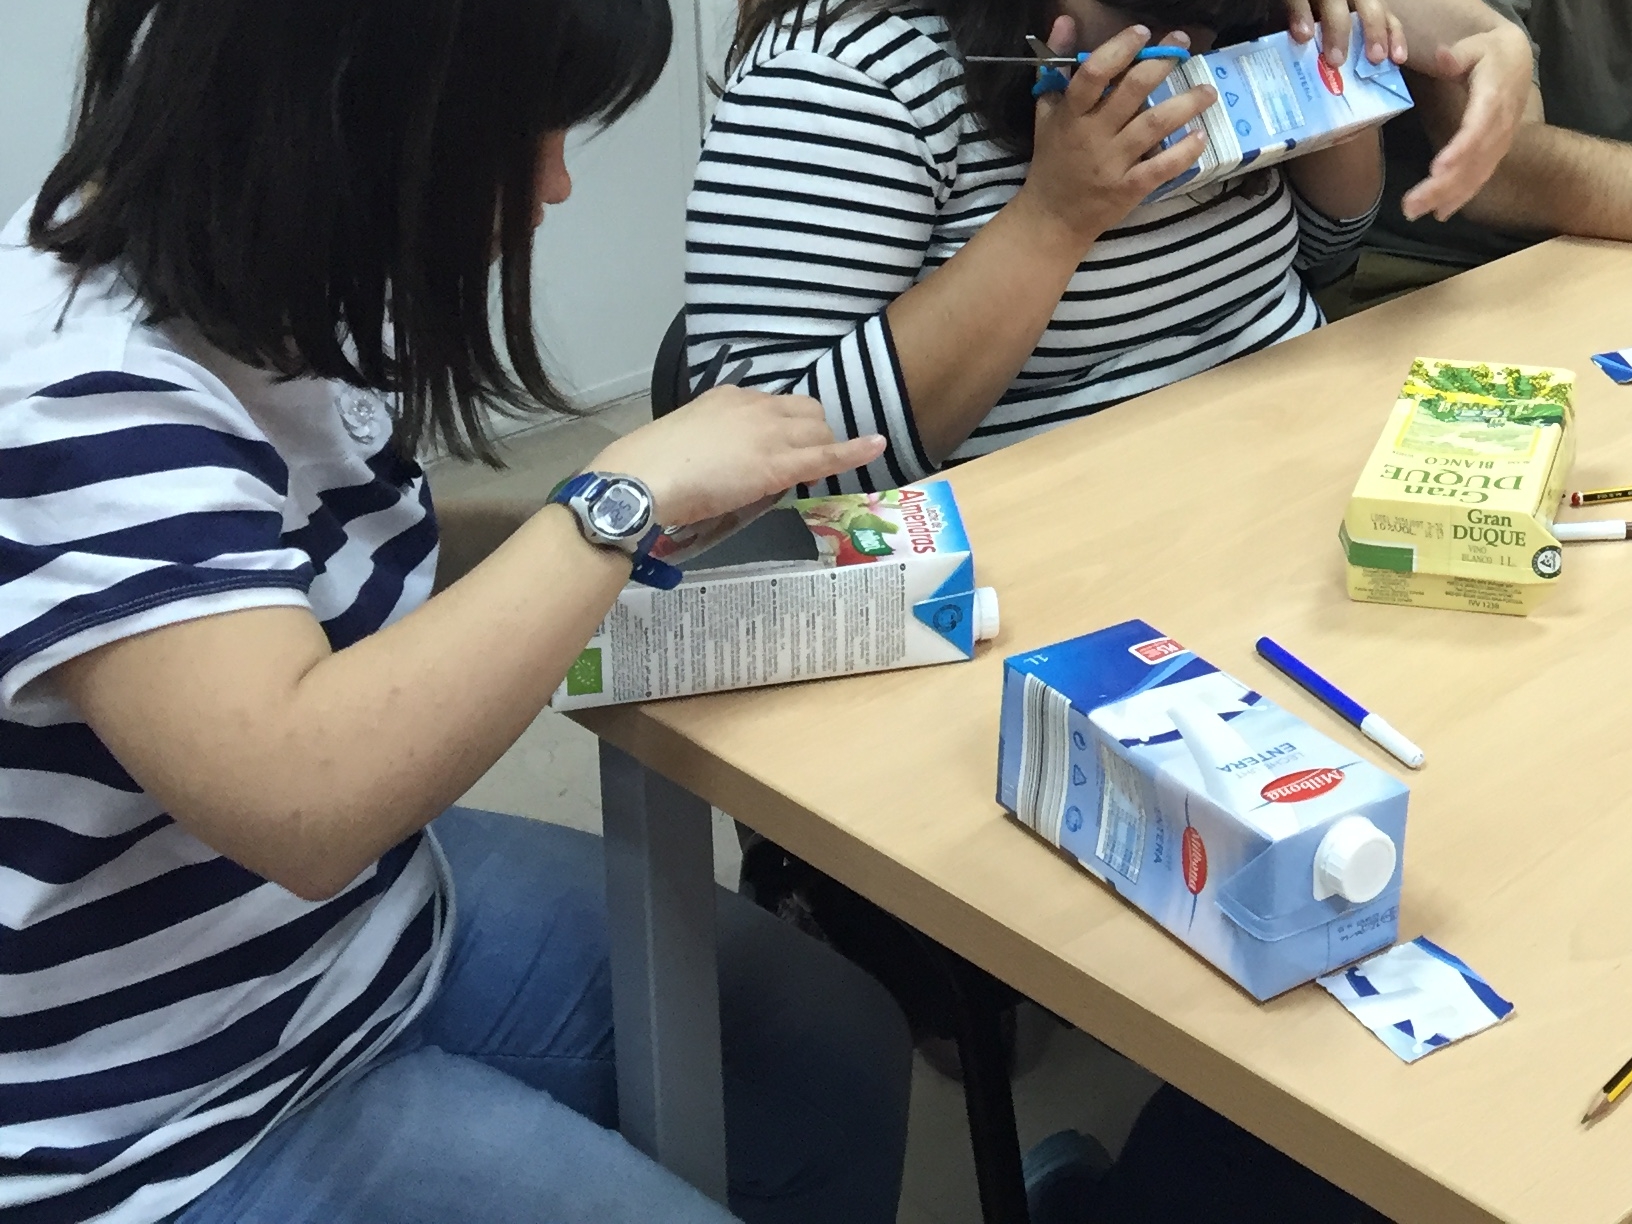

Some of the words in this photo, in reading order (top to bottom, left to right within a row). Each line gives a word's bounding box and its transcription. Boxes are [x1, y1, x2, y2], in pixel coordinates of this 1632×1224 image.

[1425, 456, 1494, 469] BLANCO
[1380, 464, 1523, 491] DUQUE
[1404, 485, 1489, 504] Gran
[898, 488, 937, 555] Almendras
[1466, 509, 1512, 528] Gran
[1452, 525, 1526, 547] DUQUE
[1461, 553, 1493, 565] BLANCO
[1467, 545, 1487, 555] VINO
[1215, 742, 1297, 773] ENTERA
[1264, 769, 1345, 801] Milbona
[1189, 830, 1204, 892] Milbona
